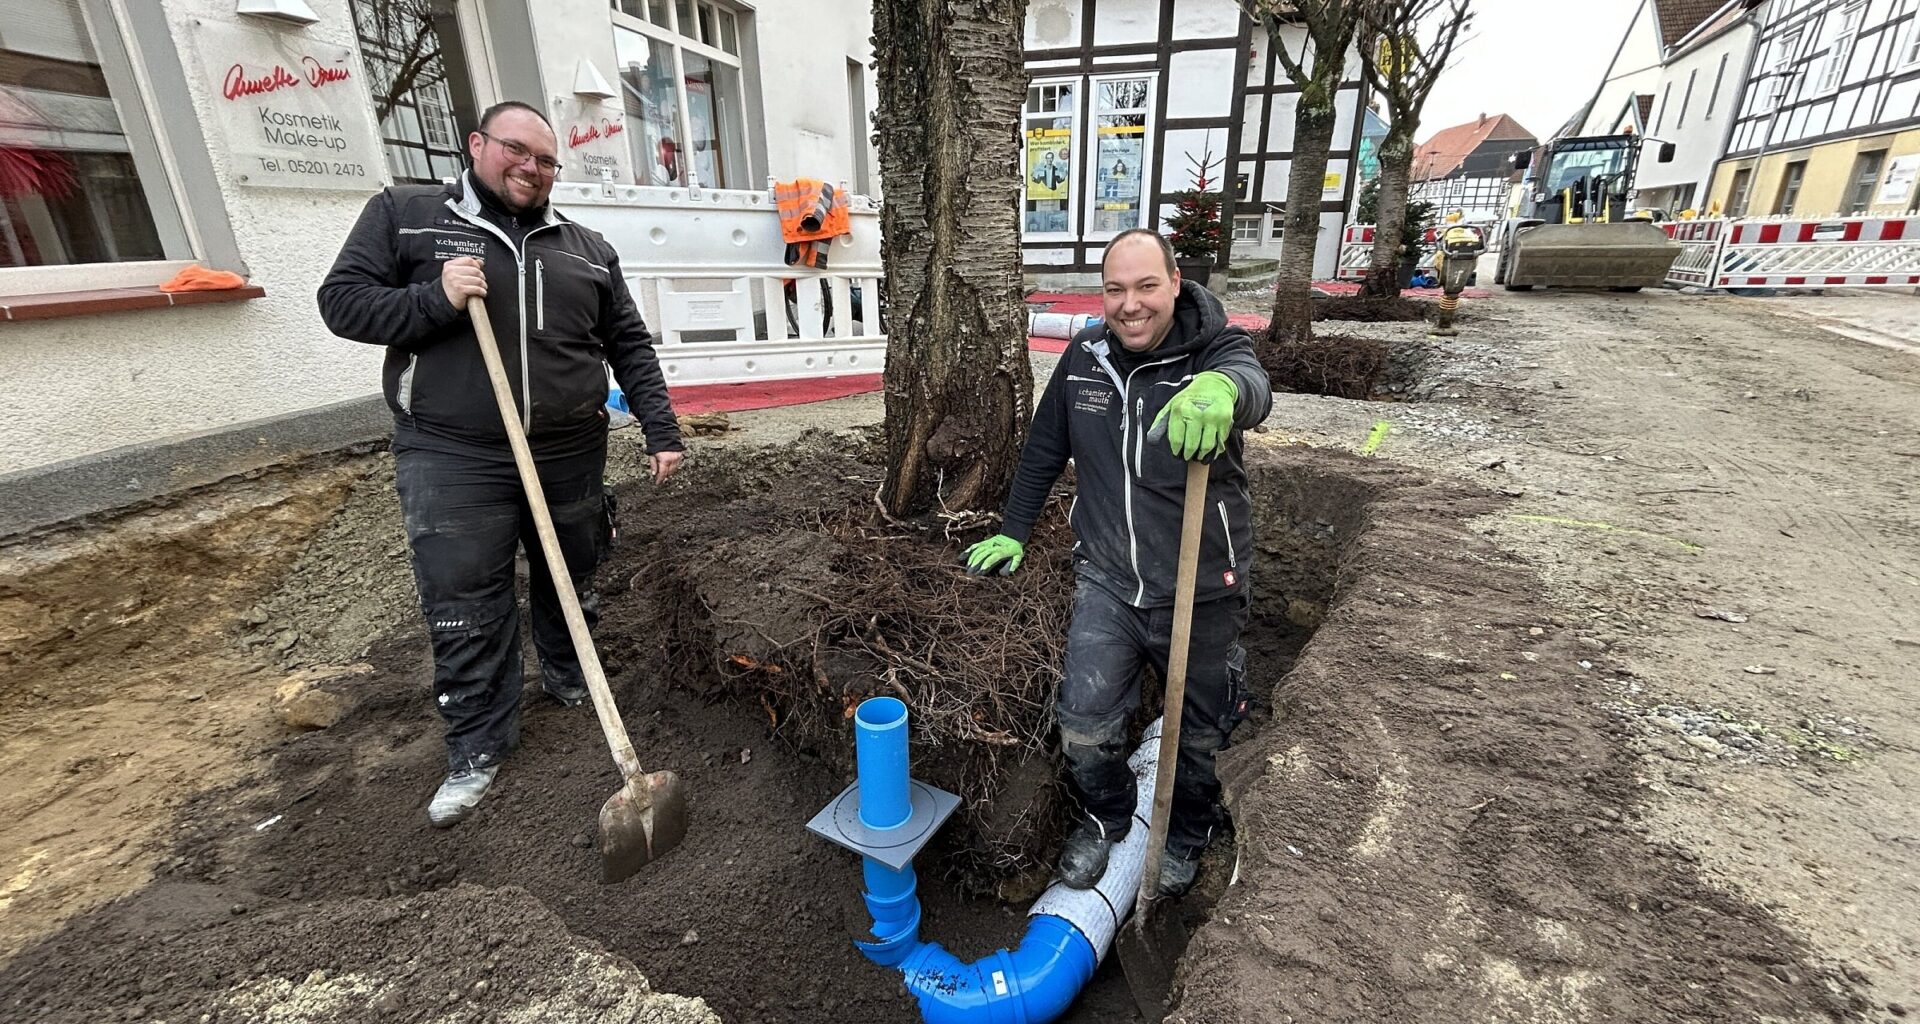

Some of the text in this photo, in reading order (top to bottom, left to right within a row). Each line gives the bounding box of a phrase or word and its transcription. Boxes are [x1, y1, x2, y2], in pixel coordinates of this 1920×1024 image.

[224, 64, 300, 101] Annette
[258, 106, 343, 132] Kosmetik
[264, 127, 347, 152] Make-up
[569, 125, 601, 149] Annette
[258, 157, 365, 177] Tel. 05201 2473
[582, 152, 618, 165] Kosmetik
[456, 246, 484, 254] mauth
